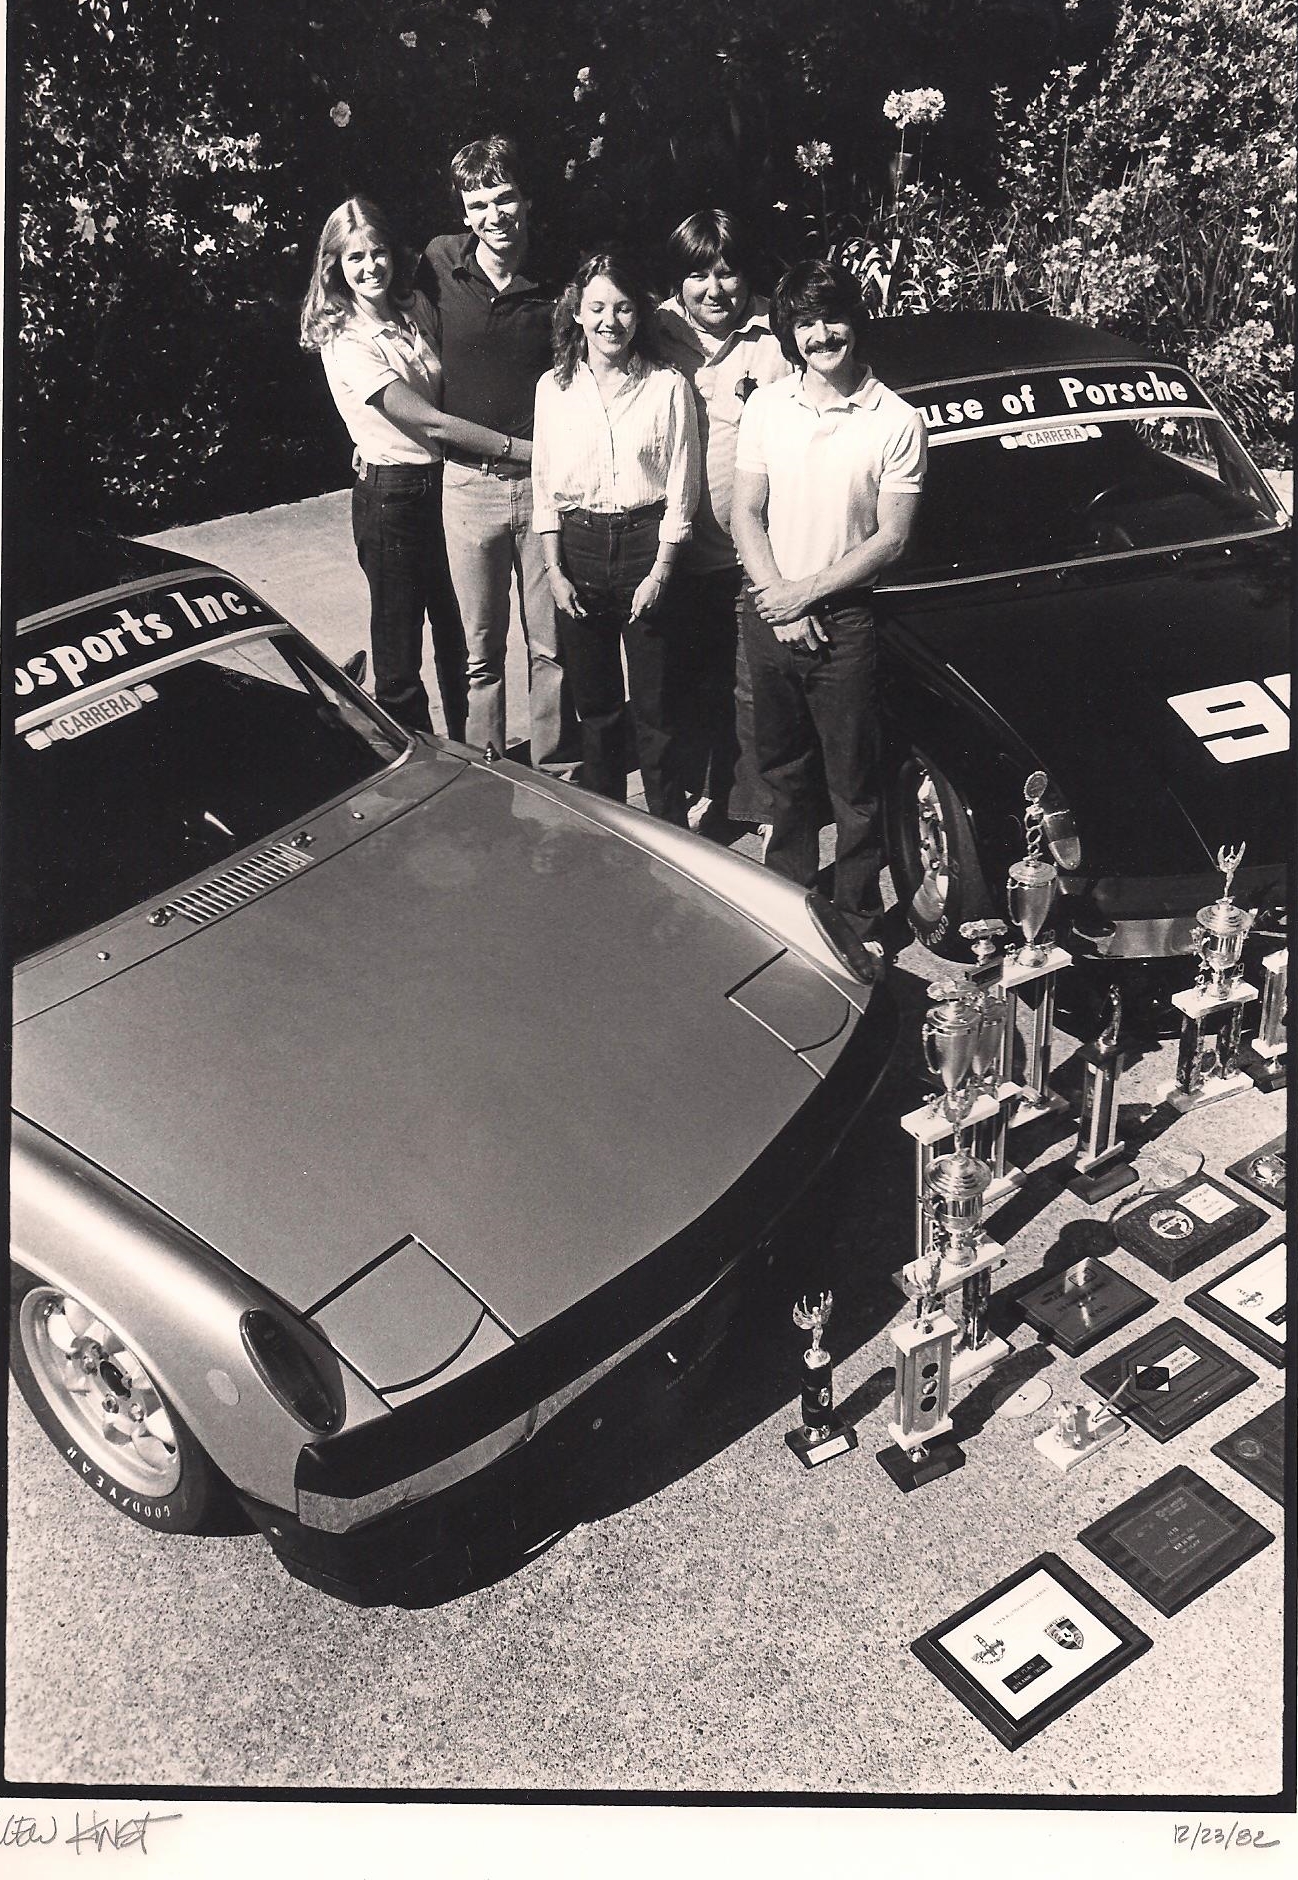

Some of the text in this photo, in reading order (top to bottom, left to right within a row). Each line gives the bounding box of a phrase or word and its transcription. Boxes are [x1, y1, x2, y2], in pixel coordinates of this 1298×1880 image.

[1001, 382, 1036, 416] of
[1058, 369, 1190, 410] Porsche
[1026, 426, 1083, 446] CARRERA
[166, 590, 263, 630] Inc.
[59, 694, 137, 735] CARRERA
[1166, 673, 1291, 765] 9
[66, 1445, 171, 1518] GOODYEAR
[1173, 1820, 1281, 1851] 12/23/82
